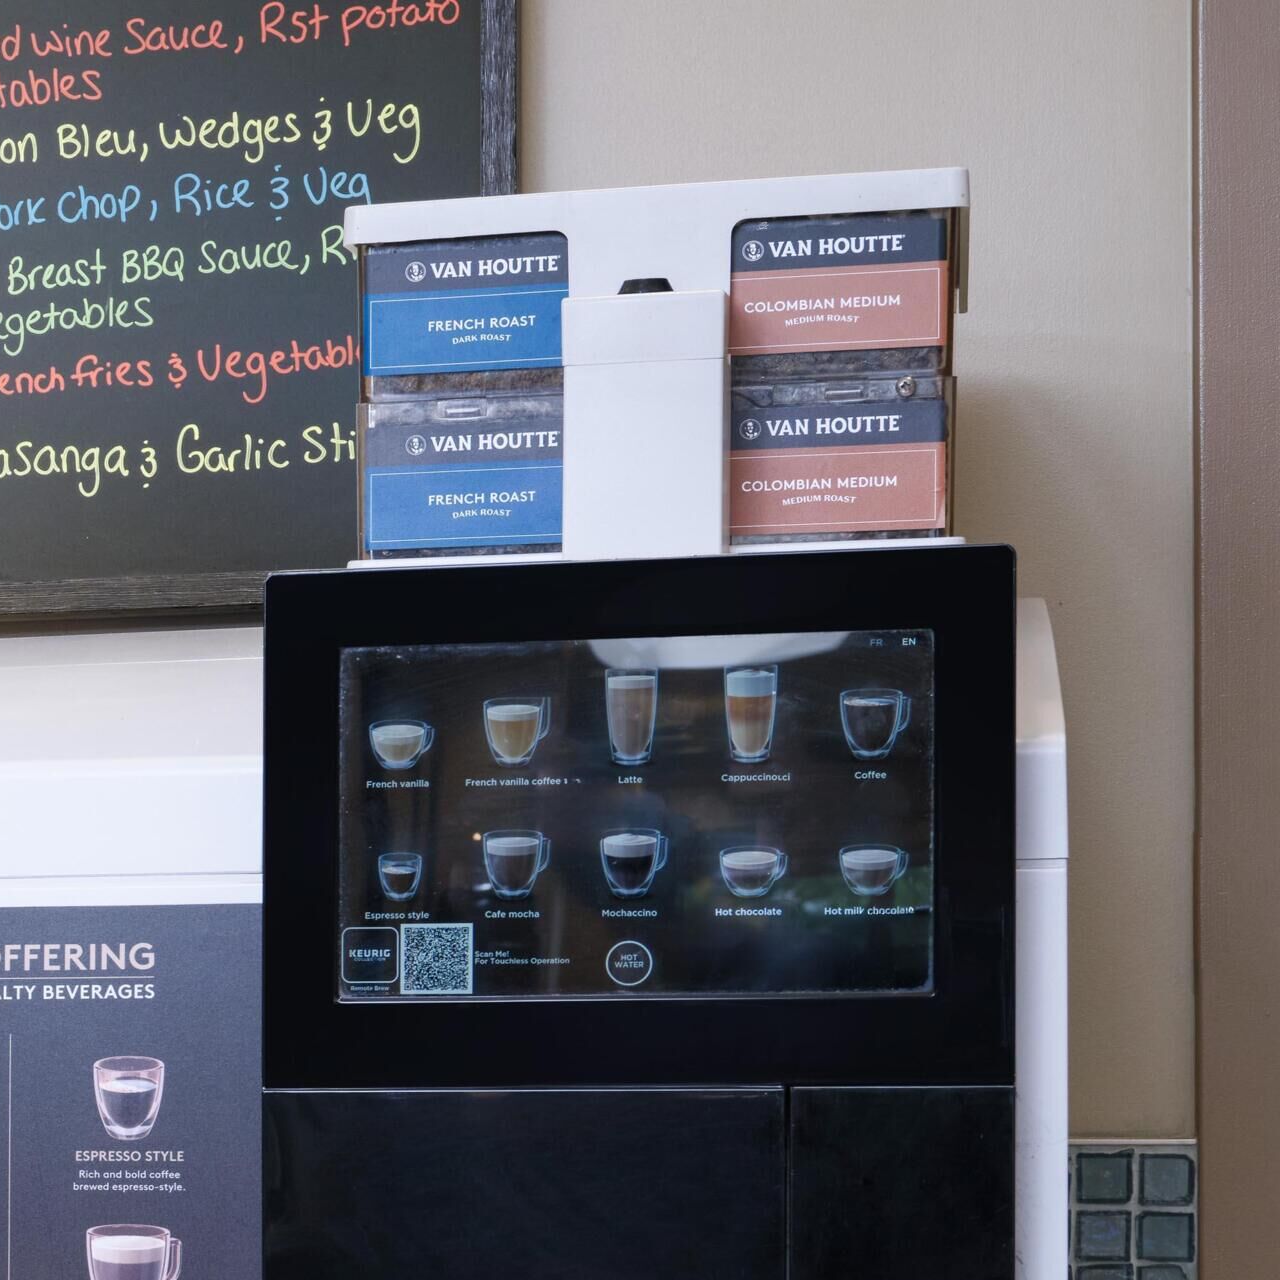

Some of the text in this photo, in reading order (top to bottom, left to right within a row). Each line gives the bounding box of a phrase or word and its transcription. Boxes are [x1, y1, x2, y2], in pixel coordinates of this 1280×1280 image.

[124, 21, 243, 57] Sauce,
[57, 118, 150, 166] Bleu,
[346, 100, 422, 162] Veg
[173, 172, 252, 213] Rice
[769, 235, 905, 258] VAN HOUTTE
[430, 257, 560, 278] VAN HOUTTE
[744, 293, 901, 315] COLOMBIAN MEDIUM
[428, 315, 537, 332] FRENCH ROAST
[785, 314, 860, 327] MEDIUM ROAST
[452, 333, 512, 345] DARK ROAST
[176, 424, 289, 474] Garlic
[902, 637, 917, 646] EN
[617, 775, 643, 785] Latte
[854, 770, 887, 780] Coffee
[366, 779, 430, 789] French vanilla
[365, 911, 430, 921] Espresso style
[485, 910, 540, 919] Cafe mocha
[601, 908, 658, 918] Mochaccino
[715, 907, 782, 917] Hot chocolate
[531, 957, 570, 965] Operation
[620, 953, 638, 961] HOT
[614, 961, 645, 969] WATER
[43, 984, 155, 1000] BEVERAGES
[75, 1150, 184, 1162] ESPRESSO STYLE
